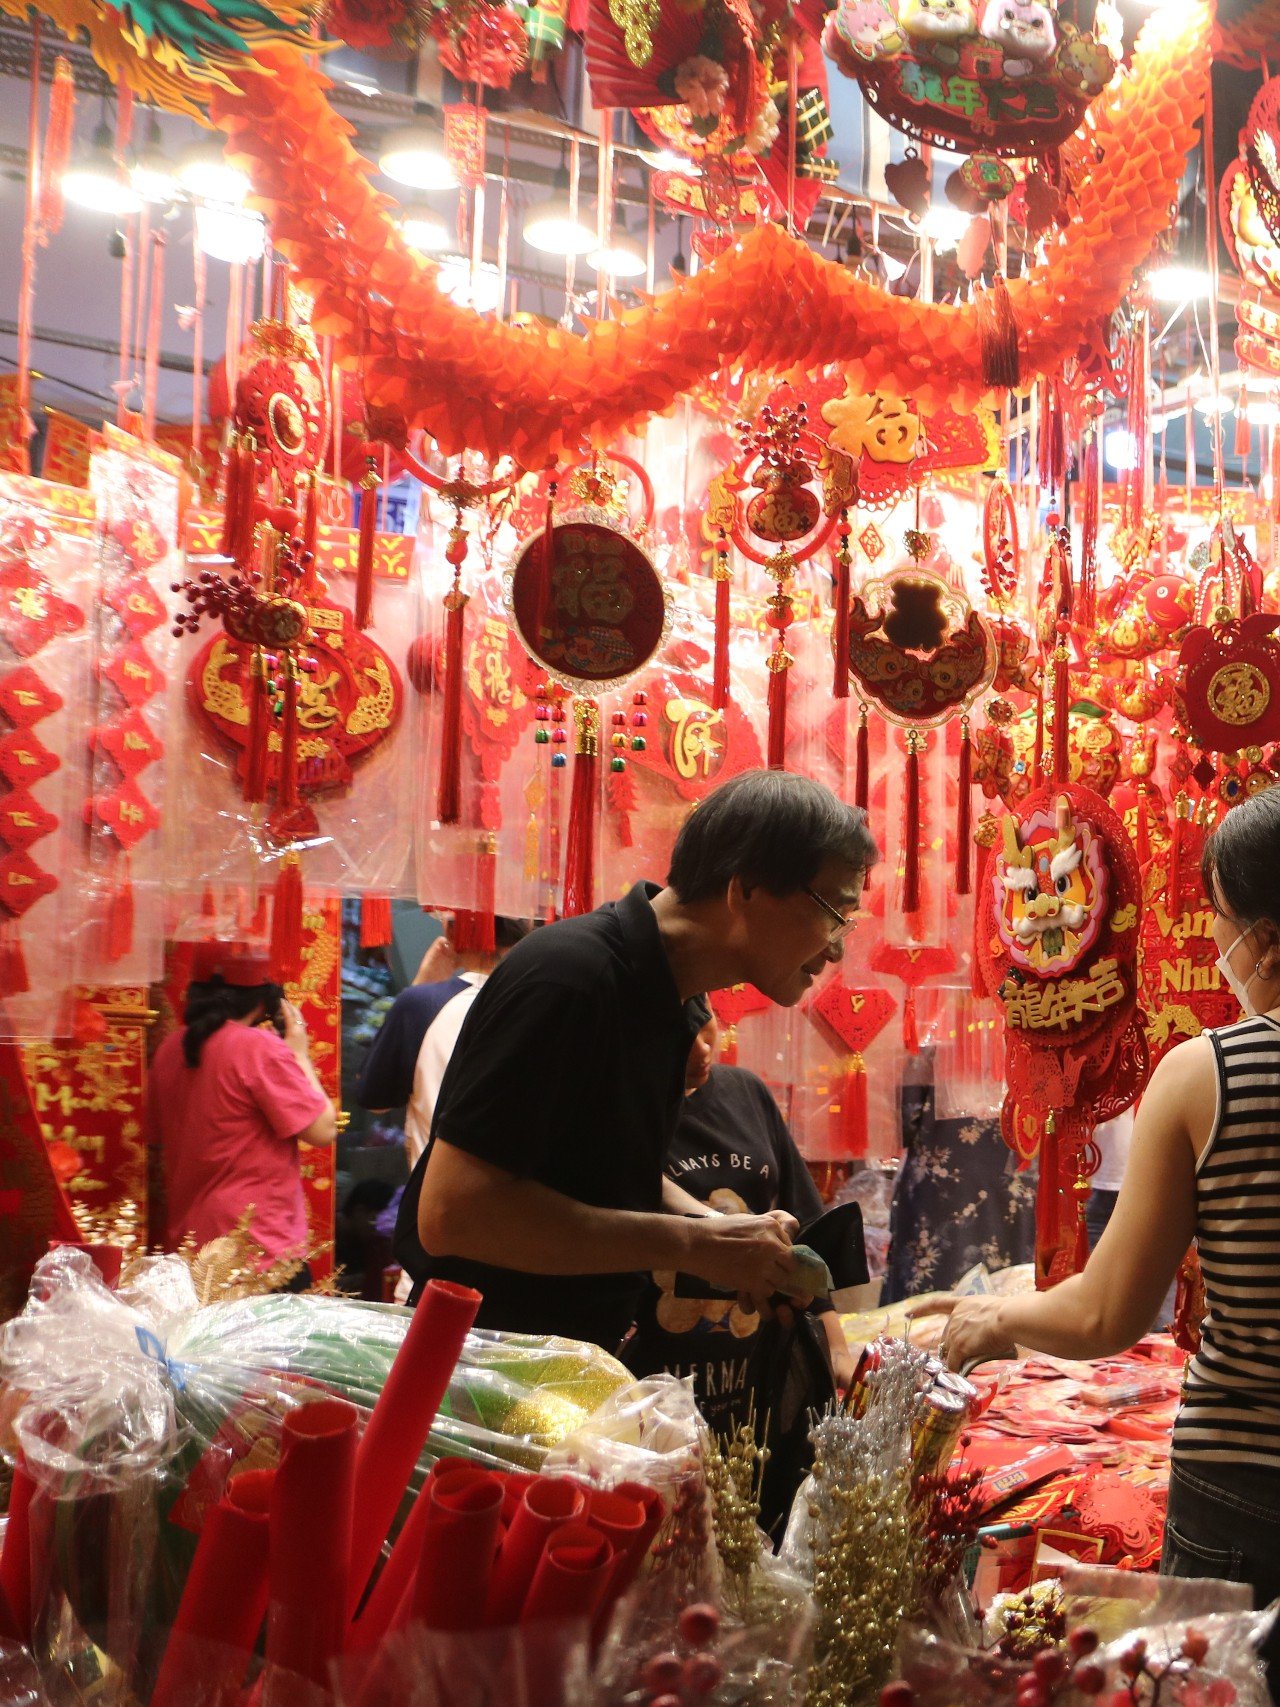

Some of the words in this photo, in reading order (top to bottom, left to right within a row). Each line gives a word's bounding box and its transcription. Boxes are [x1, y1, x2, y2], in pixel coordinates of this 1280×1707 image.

[1150, 901, 1219, 950] Vạn
[1003, 956, 1126, 1032] 龍年大吉
[666, 1152, 721, 1178] LWAYS
[729, 1152, 752, 1171] BE
[759, 1163, 771, 1180] A
